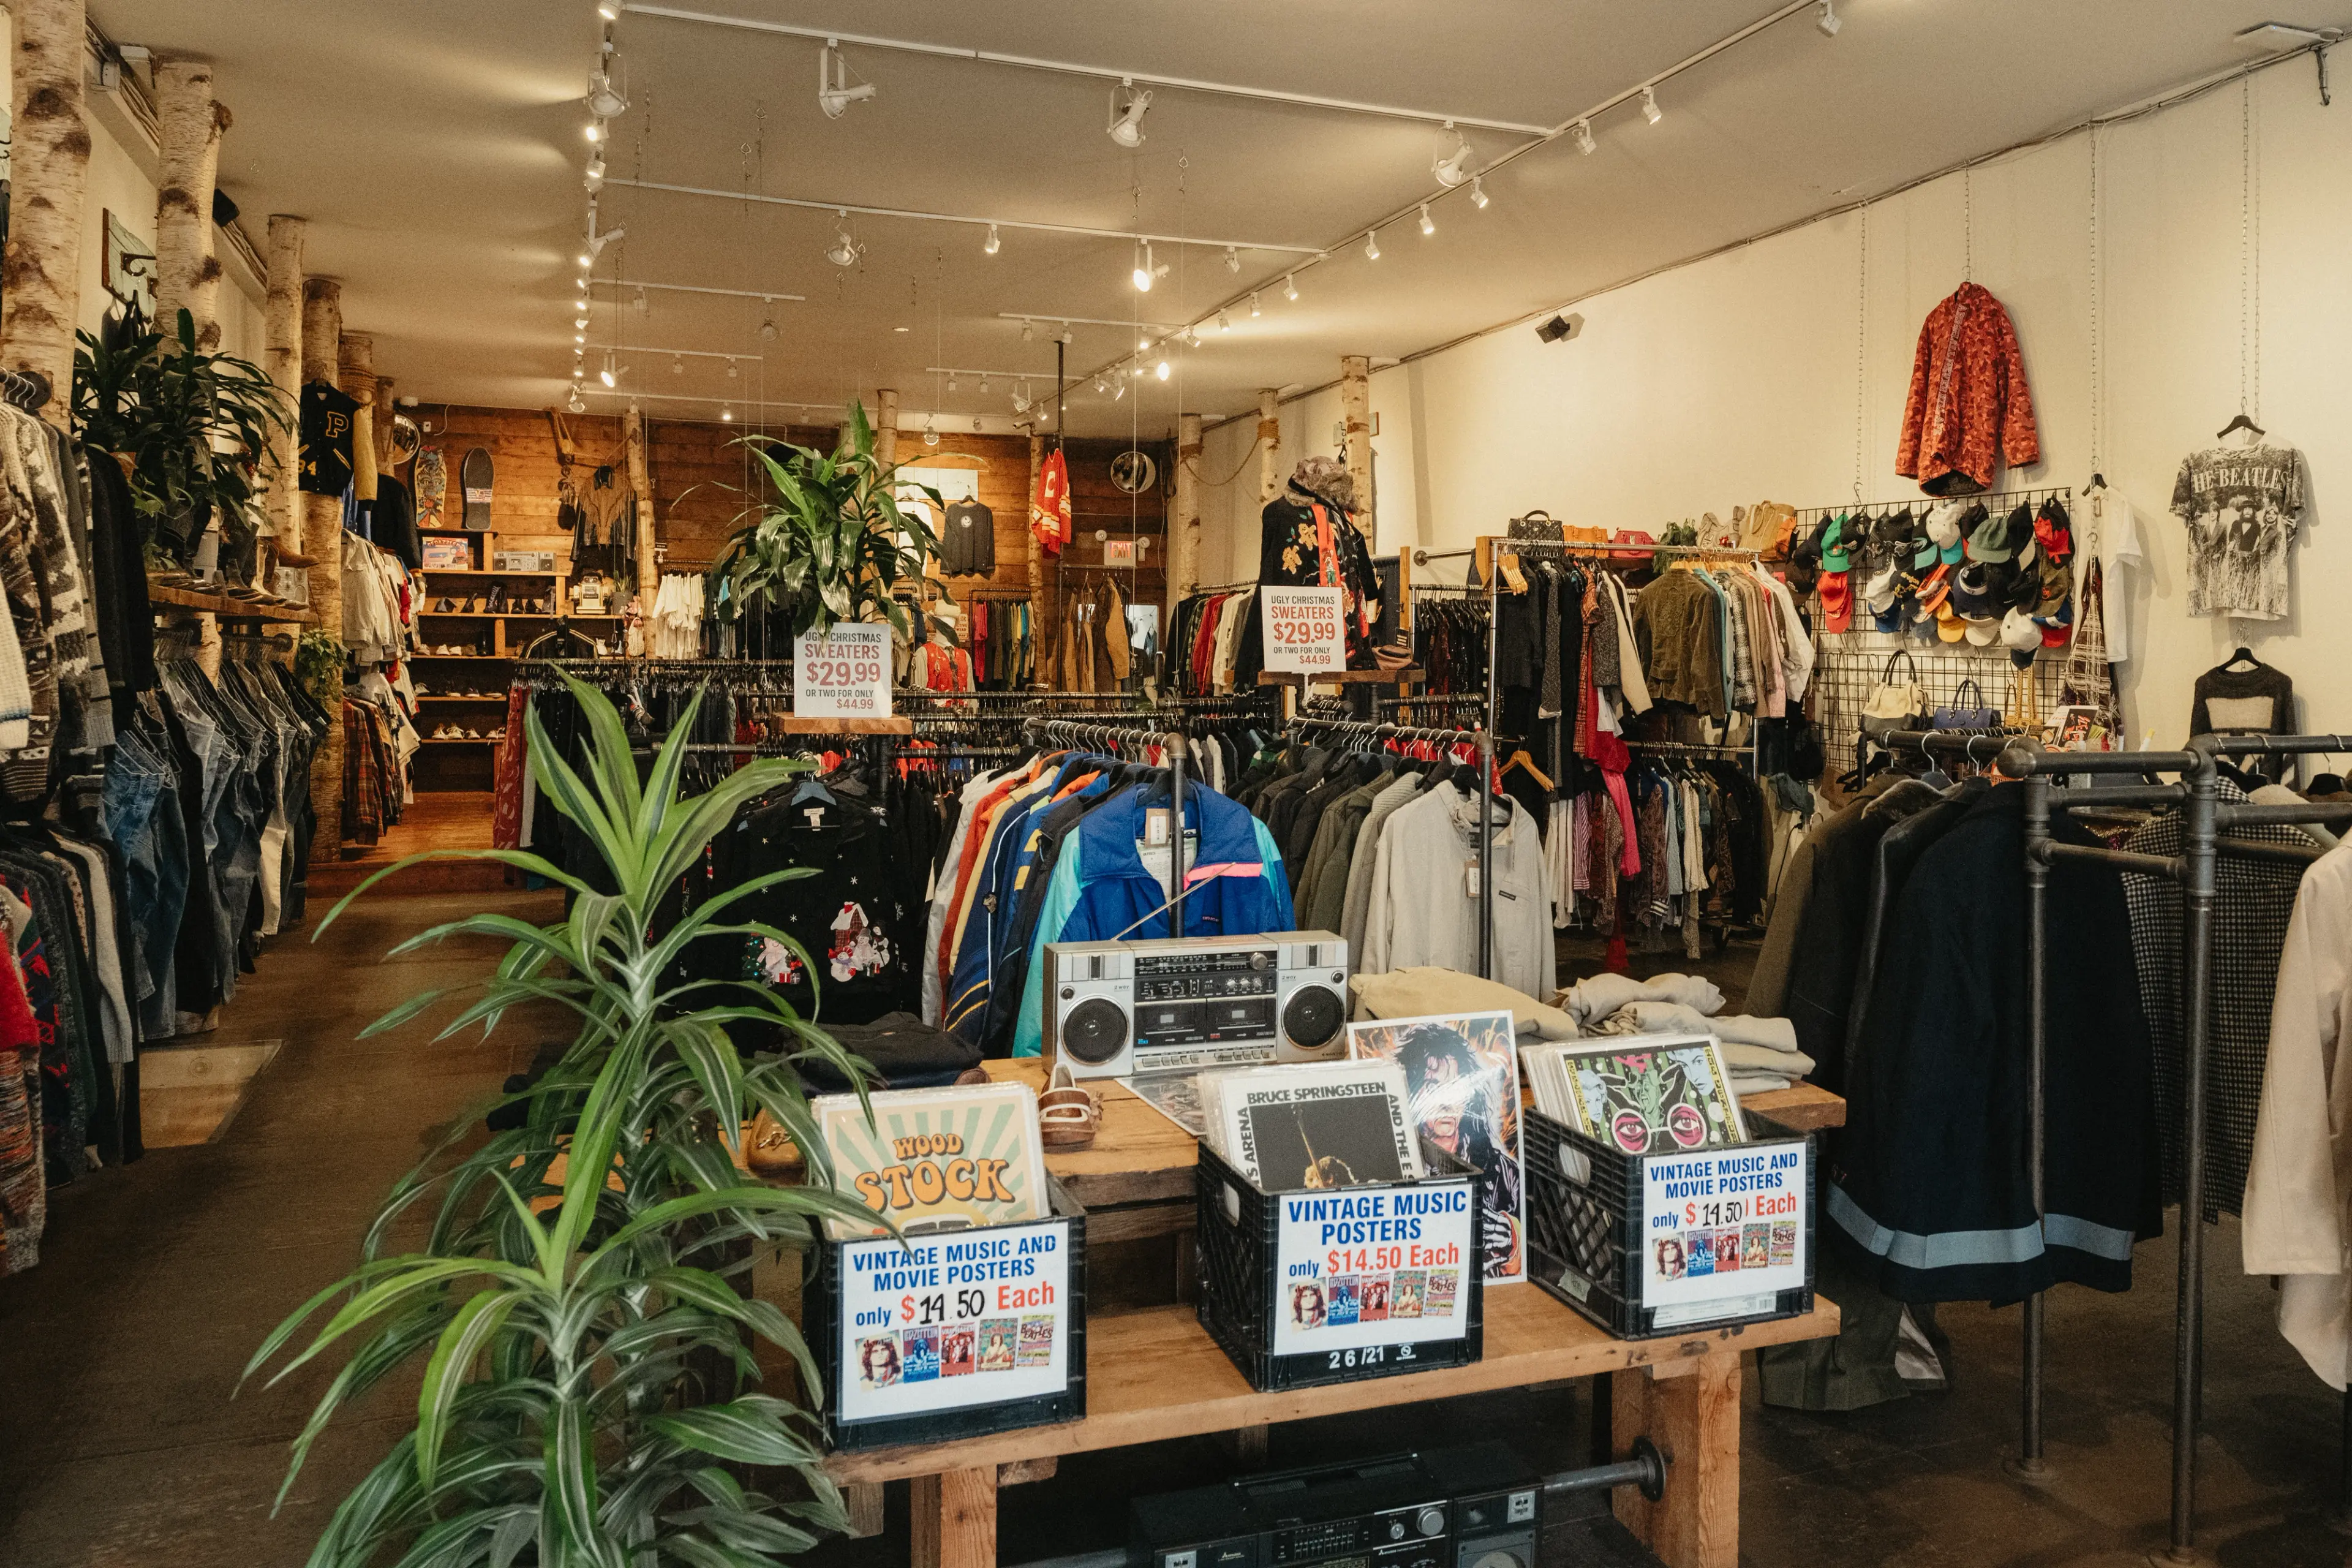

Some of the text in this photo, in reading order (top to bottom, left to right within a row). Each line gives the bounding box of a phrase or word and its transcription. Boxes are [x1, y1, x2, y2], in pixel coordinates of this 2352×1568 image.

[326, 411, 349, 438] P
[1044, 471, 1055, 497] C
[2219, 467, 2289, 491] BEATLES
[1110, 541, 1132, 559] EXIT
[1271, 595, 1335, 605] UGLY CHRISTMAS
[1271, 606, 1334, 619] SWEATERS
[830, 632, 881, 643] CHRISTMAS
[1273, 622, 1336, 644] $29.99
[805, 644, 880, 660] SWEATERS
[1299, 655, 1331, 665] $44.99
[806, 662, 881, 687] $29.99
[837, 698, 873, 709] $44.99
[1246, 1082, 1387, 1105] BRUCE SPRINGSTEEN
[1388, 1093, 1403, 1127] AND
[892, 1133, 964, 1160] WOOD
[1237, 1106, 1256, 1163] ARENA
[1395, 1130, 1410, 1159] THE
[1402, 1162, 1412, 1171] E
[1650, 1152, 1798, 1182] VINTAGE MUSIC AND
[854, 1158, 1016, 1213] STOCK
[1665, 1171, 1784, 1199] MOVIE POSTERS
[1287, 1191, 1467, 1223] VINTAGE MUSIC
[1653, 1211, 1679, 1229] only
[1755, 1192, 1797, 1216] Each
[1321, 1218, 1422, 1245] POSTERS
[853, 1235, 1057, 1272] VINTAGE MUSIC AND
[1289, 1242, 1460, 1278] only $14.50 Each
[873, 1257, 1035, 1292] MOVIE POSTERS
[855, 1306, 891, 1328] only
[997, 1281, 1055, 1311] Each
